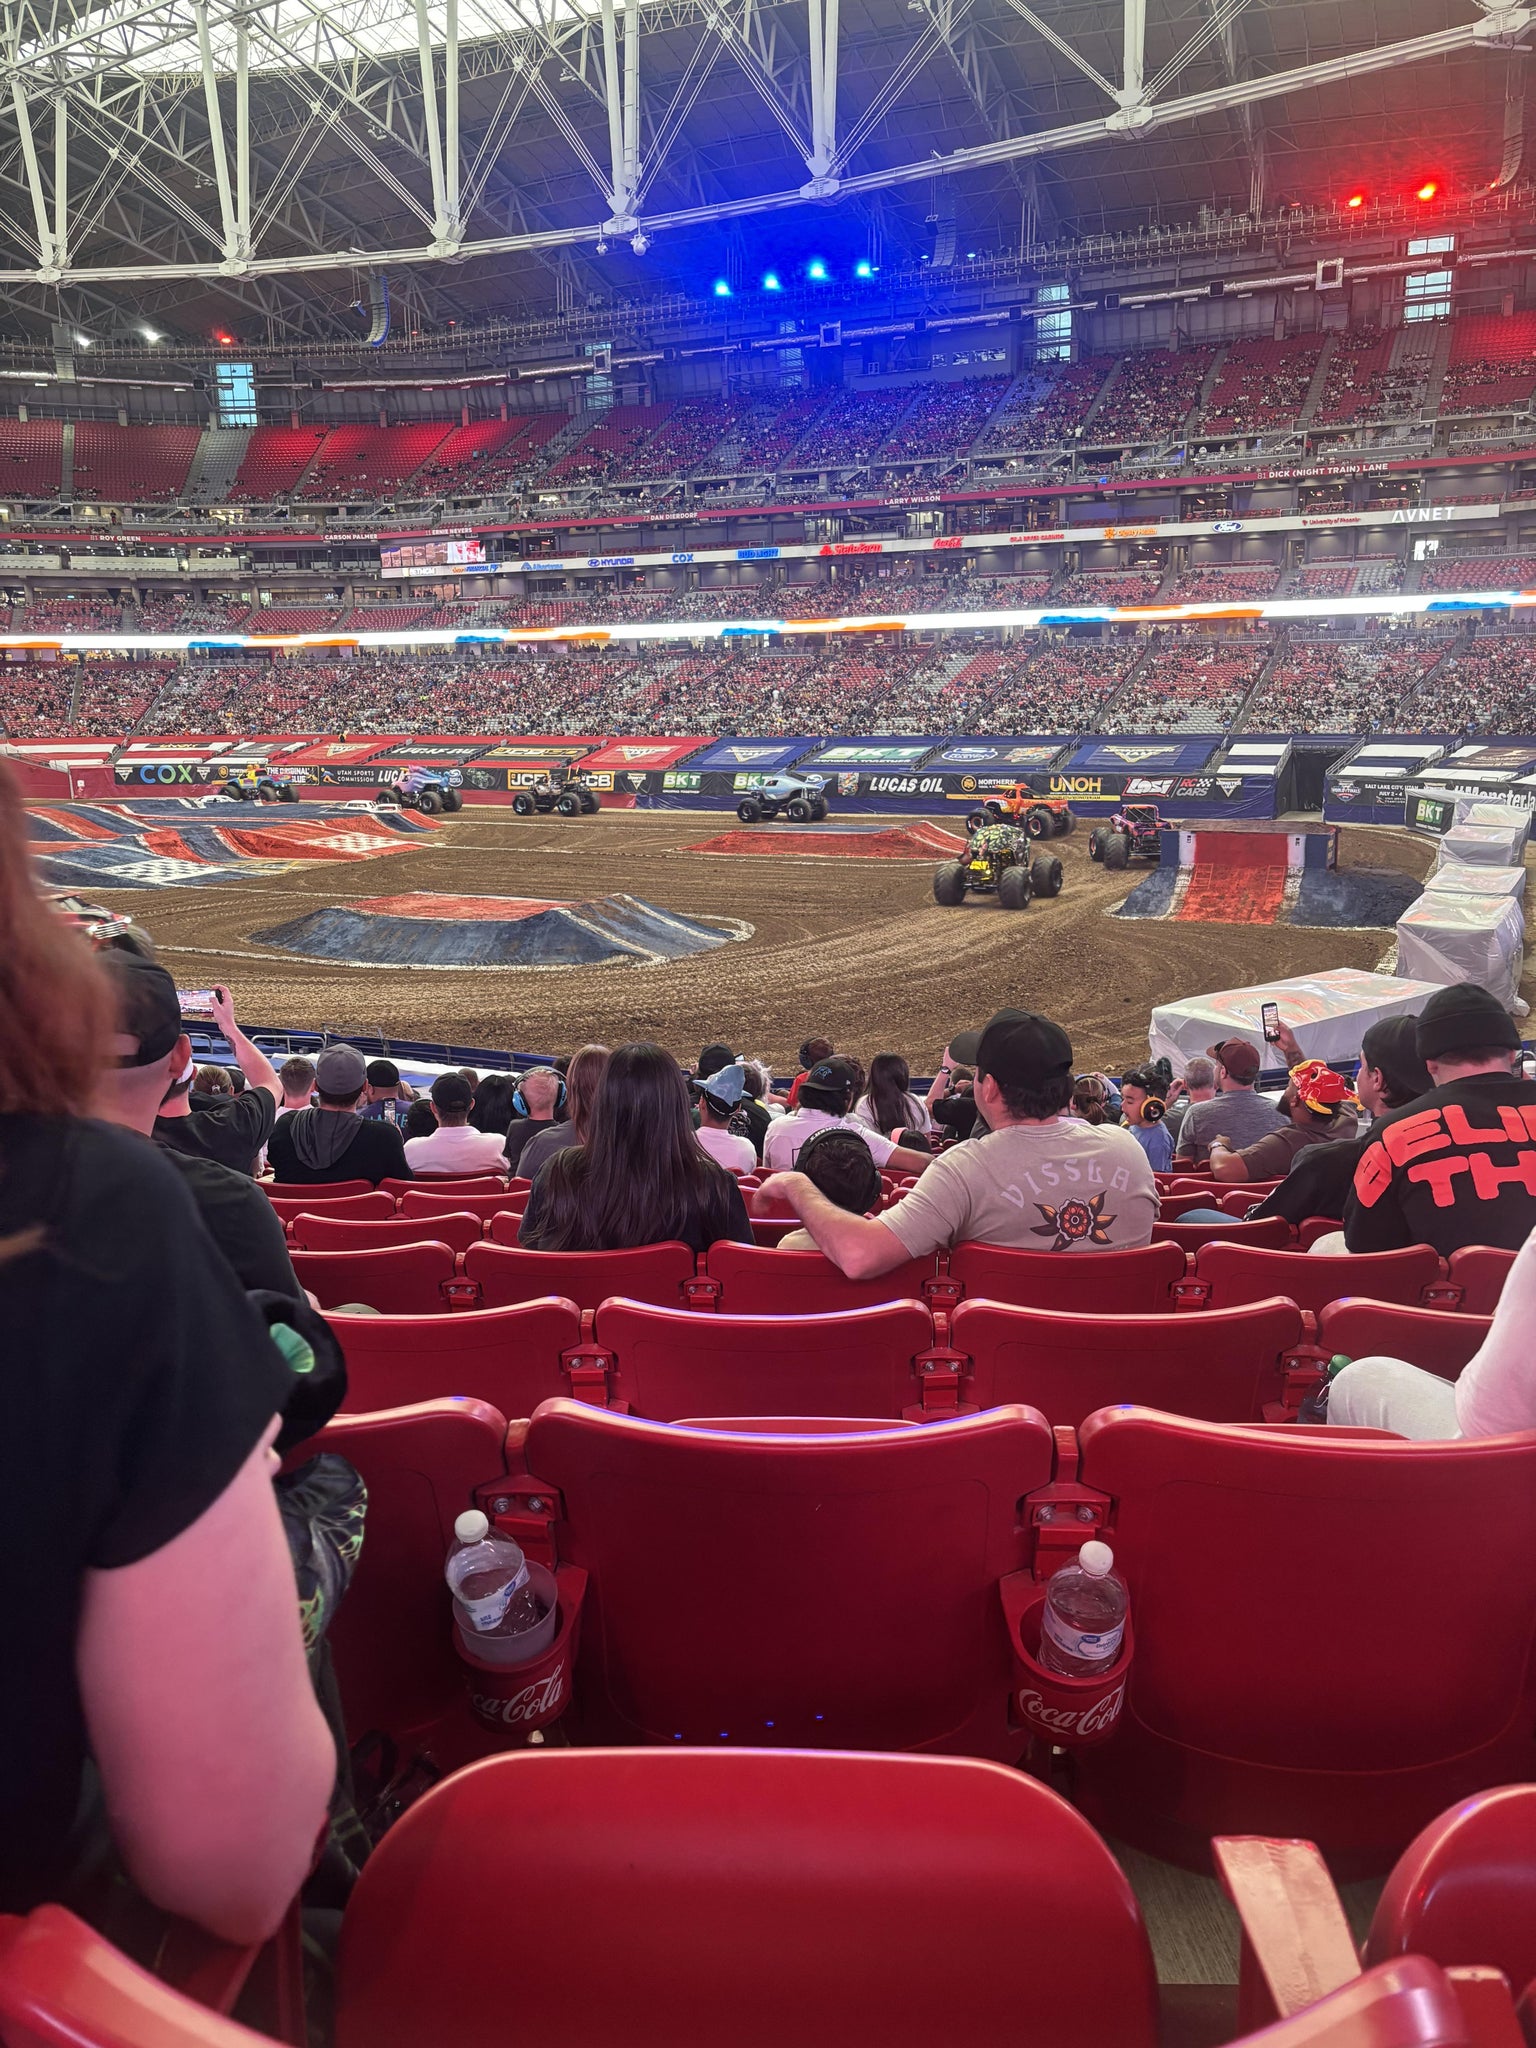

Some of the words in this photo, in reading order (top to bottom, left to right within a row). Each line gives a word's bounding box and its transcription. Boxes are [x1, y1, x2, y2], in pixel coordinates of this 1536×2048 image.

[1268, 470, 1290, 479] DICK
[1292, 467, 1325, 478] (NIGHT
[1327, 465, 1360, 475] TRAIN)
[1362, 463, 1389, 472] LANE
[884, 497, 909, 505] LARRY
[911, 495, 941, 504] WILSON
[650, 513, 664, 521] DAN
[665, 512, 698, 520] DIERDORF
[1391, 507, 1456, 524] AVNET
[601, 557, 634, 566] HYUNDAI
[672, 554, 694, 563] COX
[825, 746, 925, 758] BKT
[140, 764, 193, 784] COX
[266, 766, 279, 775] THE
[377, 769, 404, 783] LUCA
[663, 773, 701, 787] BKT
[869, 776, 917, 793] LUCAS
[1050, 777, 1101, 792] UNOH
[1180, 778, 1198, 787] RC
[1176, 787, 1209, 797] CARS
[1416, 803, 1444, 820] BKT
[1353, 1104, 1536, 1208] BELI
[1000, 1158, 1130, 1209] VISSLA
[472, 1658, 565, 1723] ca-Cola
[1018, 1671, 1127, 1736] Coca-Col
